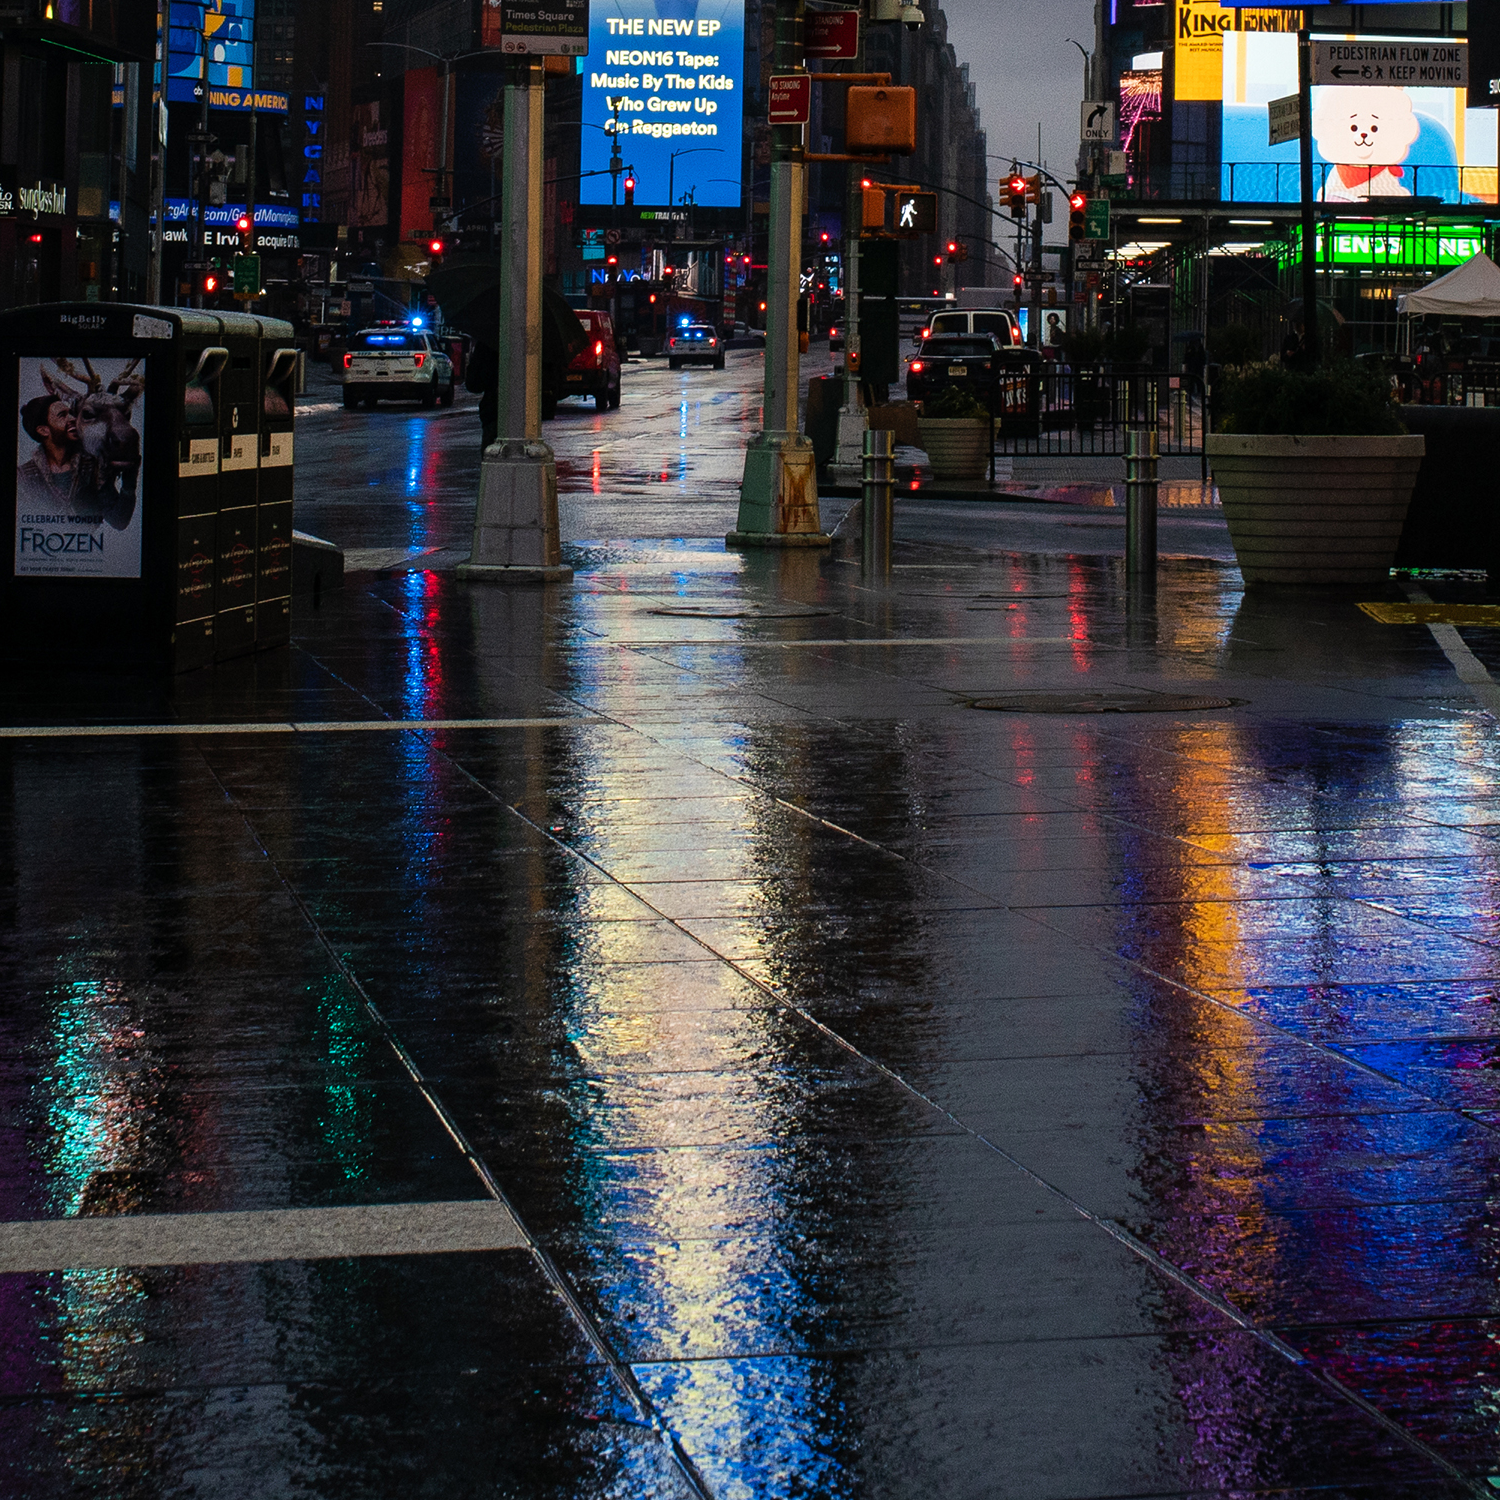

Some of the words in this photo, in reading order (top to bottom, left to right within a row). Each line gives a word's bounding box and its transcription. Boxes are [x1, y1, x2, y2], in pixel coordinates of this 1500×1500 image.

[505, 9, 536, 20] Times
[538, 10, 575, 22] Square
[814, 12, 845, 27] STANDING
[1178, 7, 1231, 39] KING
[505, 21, 557, 33] Pedestrian
[558, 23, 584, 34] Plaza
[606, 18, 644, 36] THE
[648, 18, 694, 37] NEW
[697, 19, 721, 37] EP
[606, 50, 674, 67] NEON16
[675, 51, 720, 70] Tape:
[1329, 45, 1399, 63] PEDESTRIAN
[1400, 46, 1429, 62] FLOW
[1432, 46, 1461, 63] ZONE
[1388, 65, 1418, 82] KEEP
[1419, 65, 1462, 82] MOVING
[591, 73, 640, 90] Music
[642, 73, 664, 94] By
[665, 73, 697, 90] The
[698, 73, 734, 91] Kids
[771, 91, 791, 101] Anytime
[606, 96, 645, 113] Who
[646, 96, 692, 113] Grew
[694, 96, 718, 116] Up
[604, 118, 629, 135] On
[632, 118, 718, 139] Reggaeton
[1085, 129, 1109, 139] ONLY
[59, 313, 107, 325] BigBelly
[78, 322, 100, 330] SOLAR
[21, 514, 66, 525] CELEBRATE
[66, 514, 104, 525] WONDER
[20, 527, 104, 560] FROZEN
